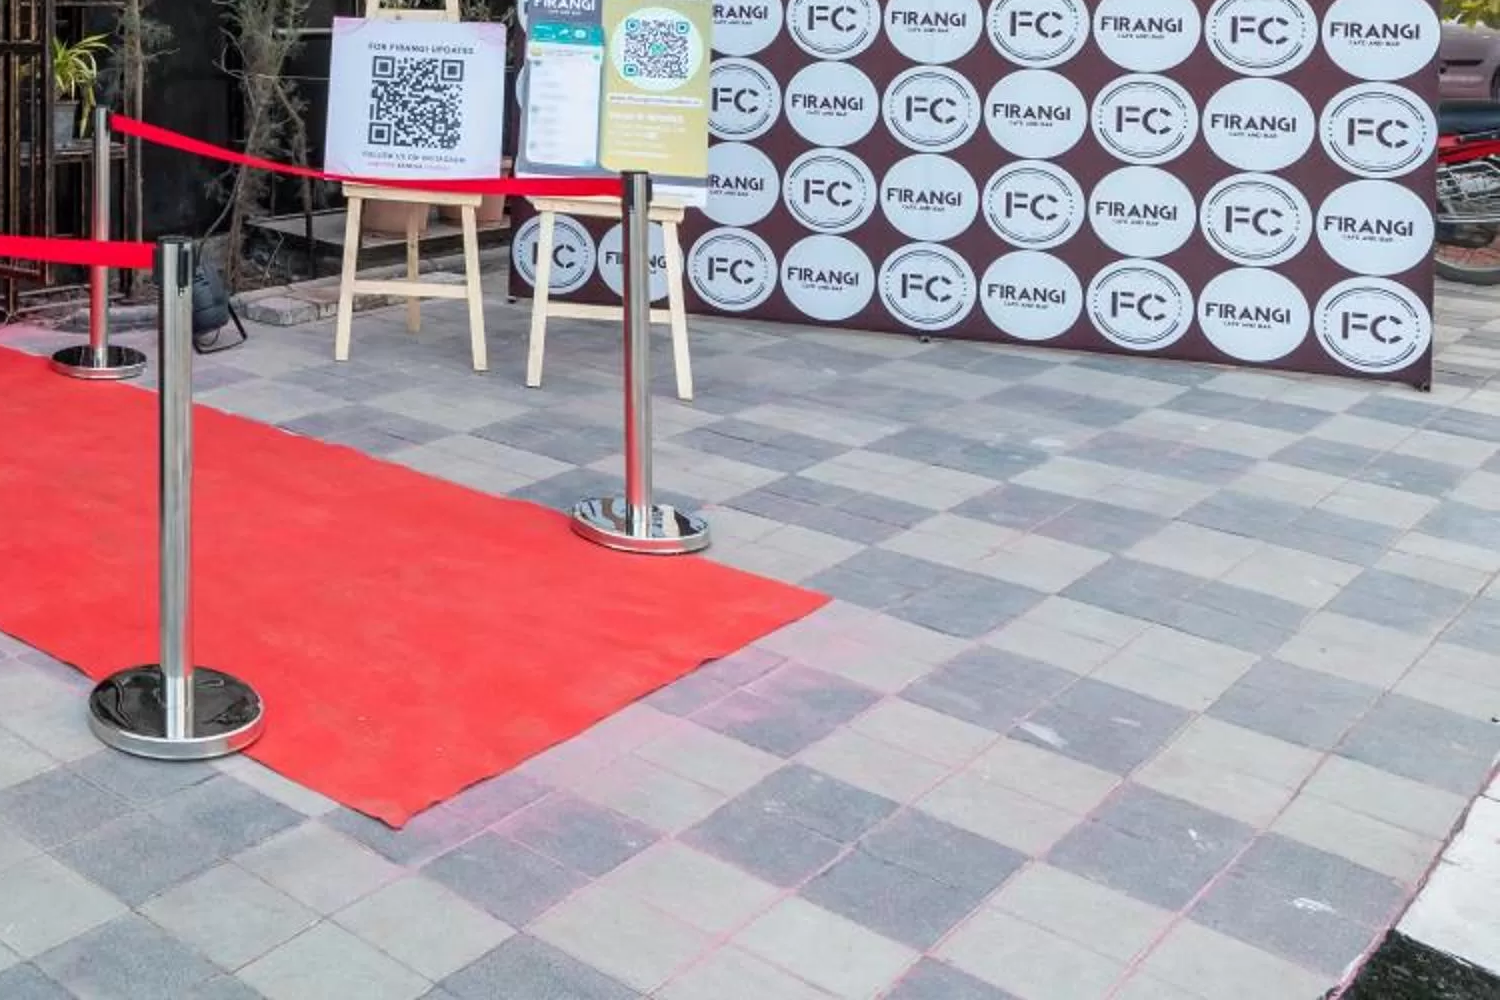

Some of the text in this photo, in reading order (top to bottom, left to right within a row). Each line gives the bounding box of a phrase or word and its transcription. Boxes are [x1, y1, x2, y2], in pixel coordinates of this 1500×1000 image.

[713, 5, 769, 20] RANGI
[807, 4, 856, 32] FC
[891, 10, 966, 27] FIRANGI
[1009, 9, 1063, 39] FC
[1100, 15, 1182, 33] FIRANGI
[1230, 15, 1288, 45] FC
[1329, 21, 1420, 39] FIRANGI
[711, 86, 758, 114] FC
[791, 93, 863, 111] FIRANGI
[905, 95, 956, 125] FC
[992, 102, 1070, 121] FIRANGI
[1115, 105, 1171, 136] FC
[1210, 112, 1296, 132] FIRANGI
[1346, 116, 1408, 149] FC
[710, 174, 765, 192] RANGI
[803, 178, 852, 207] FC
[886, 187, 961, 206] FIRANGI
[1004, 190, 1058, 222] FC
[1095, 200, 1177, 220] FIRANGI
[1224, 204, 1283, 237] FC
[1323, 215, 1413, 236] FIRANGI
[707, 255, 754, 285] FC
[787, 266, 858, 286] FIRANGI
[900, 272, 951, 303] FC
[987, 282, 1065, 304] FIRANGI
[1110, 289, 1166, 322] FC
[1205, 301, 1290, 324] FIRANGI
[1341, 310, 1402, 345] FC
